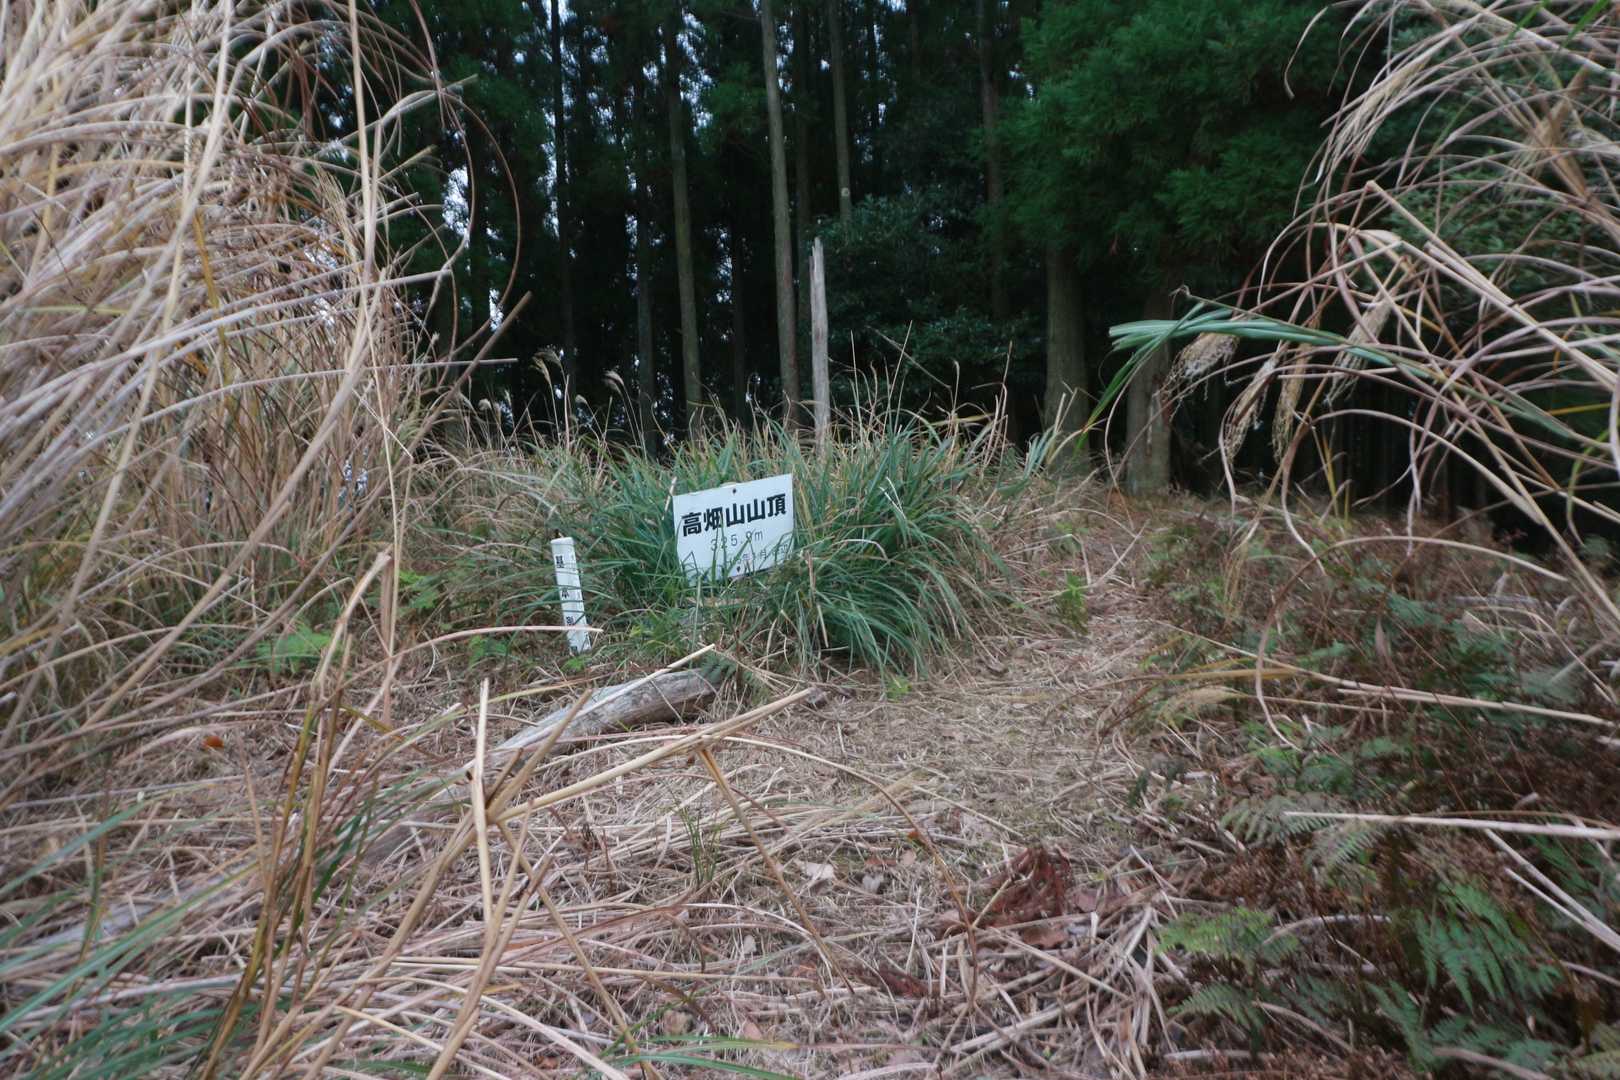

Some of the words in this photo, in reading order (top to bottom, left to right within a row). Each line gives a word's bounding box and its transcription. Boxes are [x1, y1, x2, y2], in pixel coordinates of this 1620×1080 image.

[681, 493, 787, 537] 高畑山山頂
